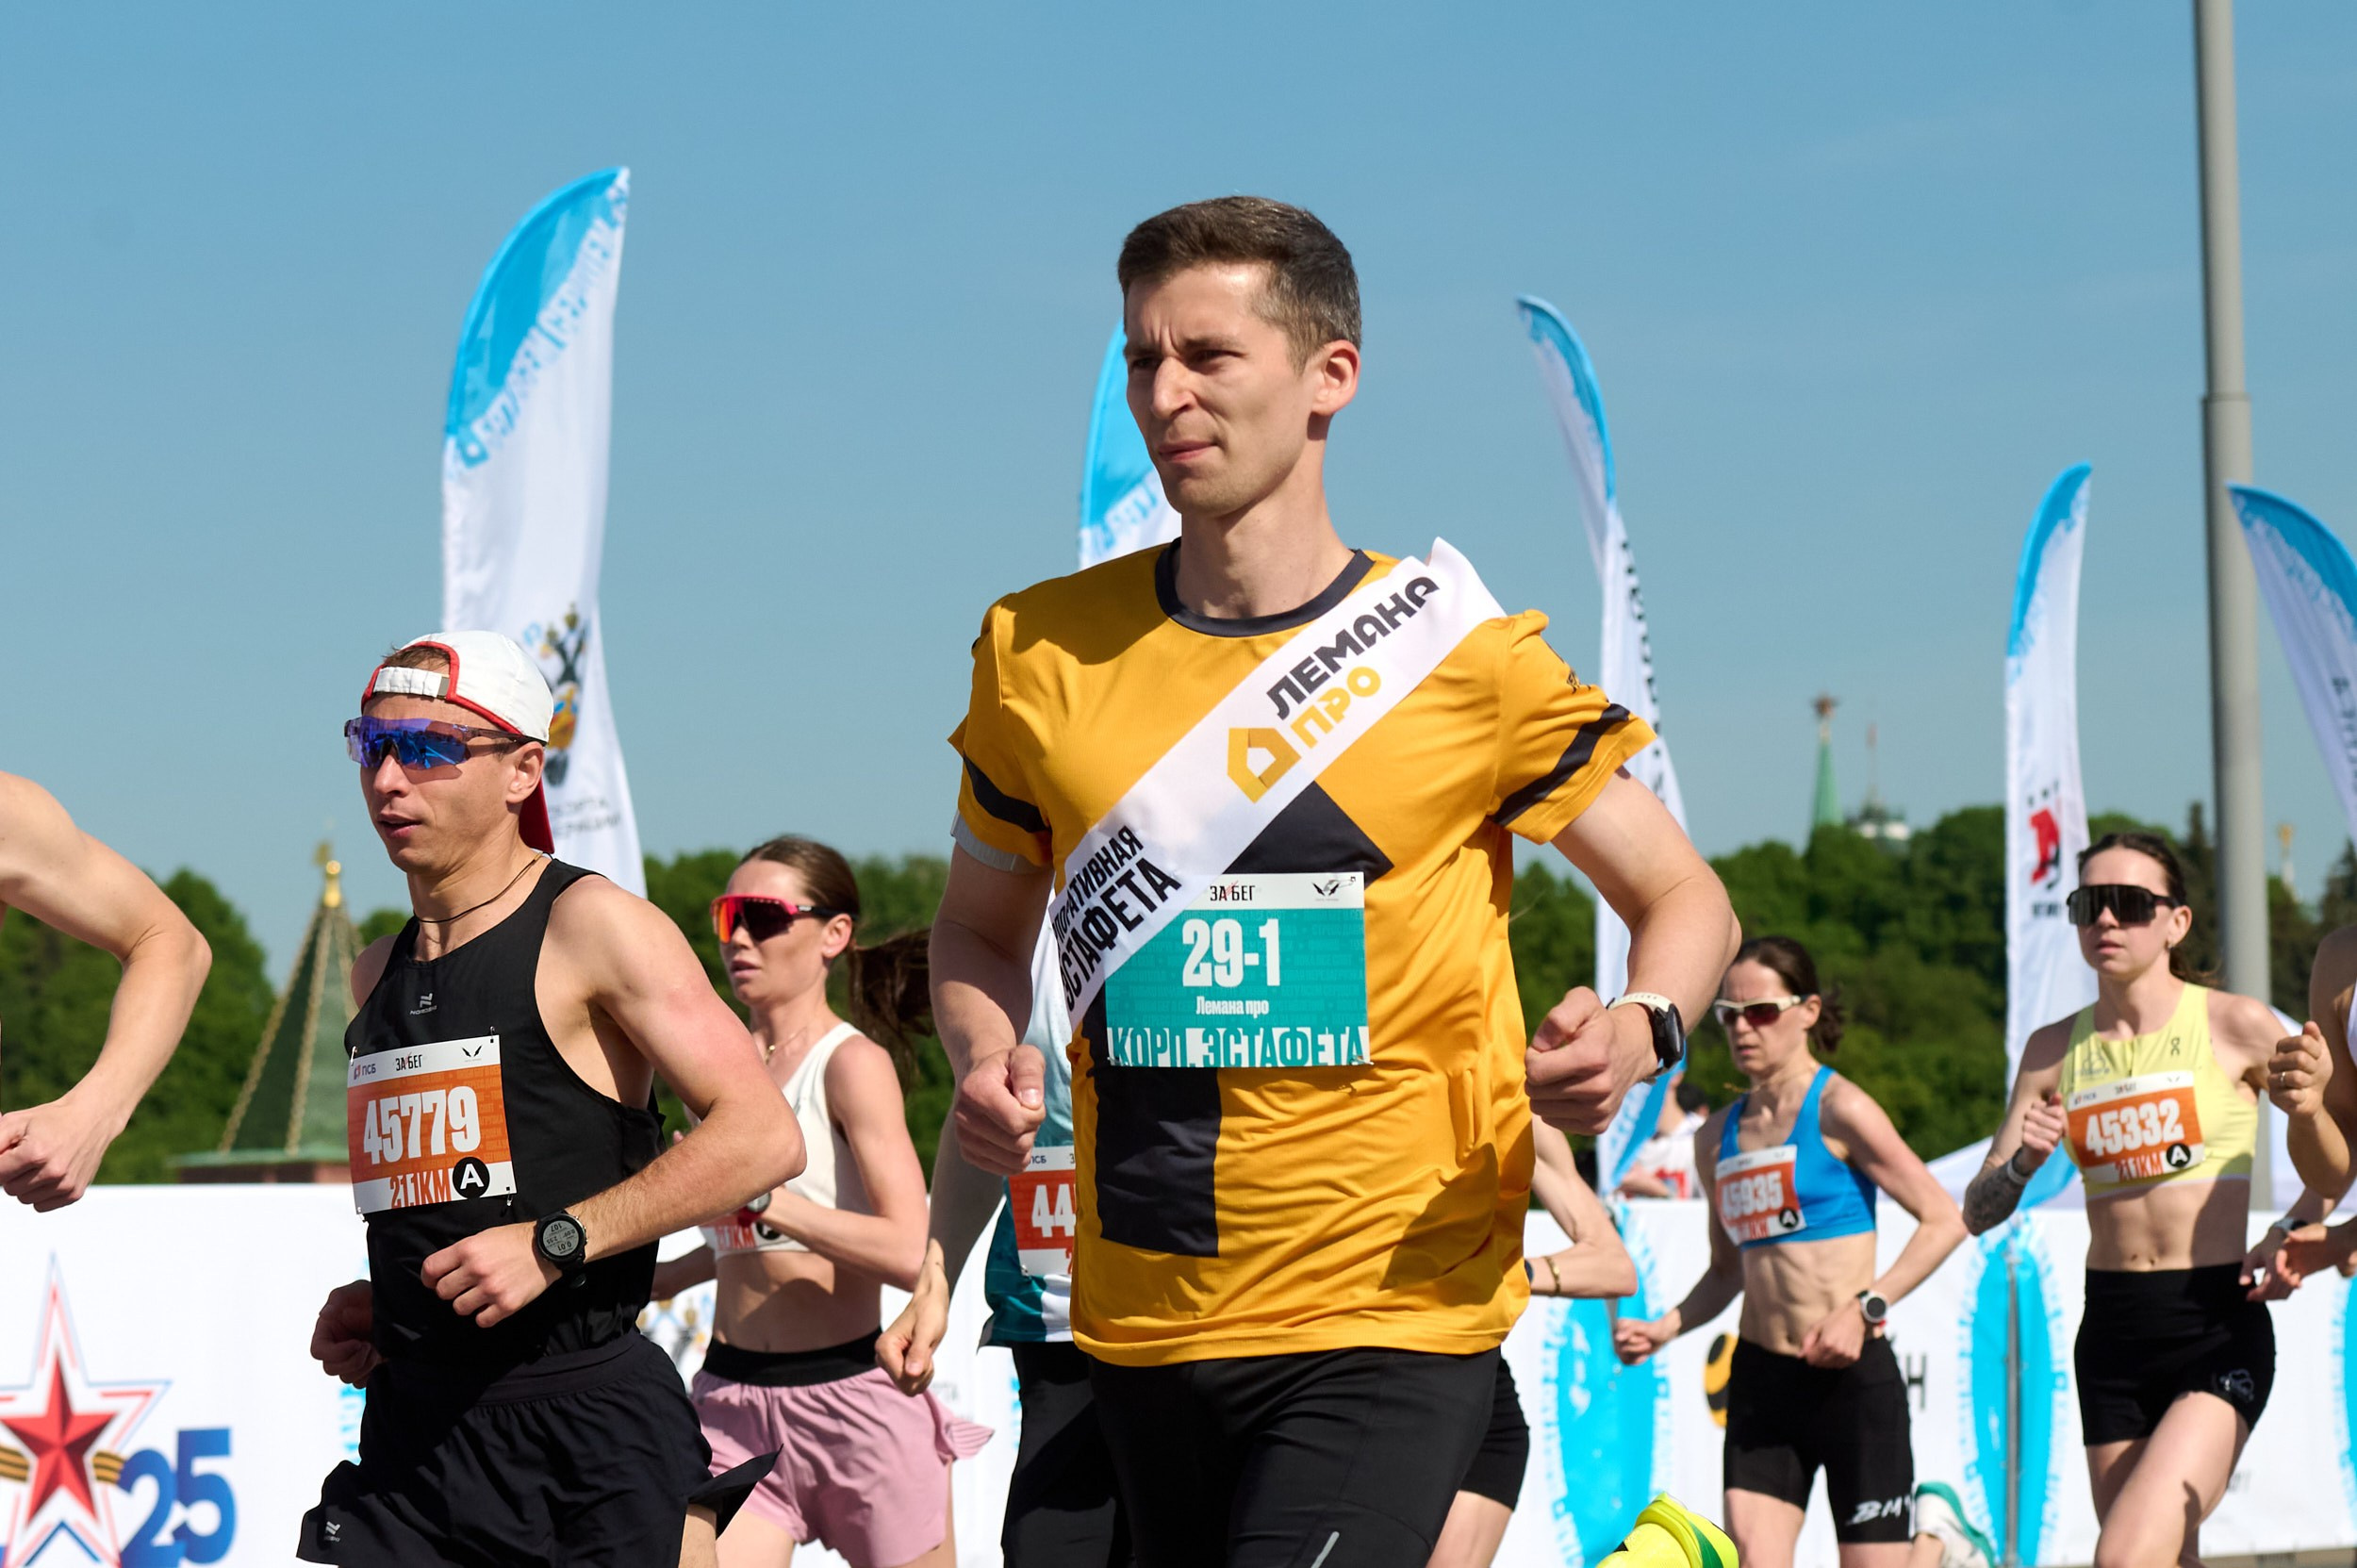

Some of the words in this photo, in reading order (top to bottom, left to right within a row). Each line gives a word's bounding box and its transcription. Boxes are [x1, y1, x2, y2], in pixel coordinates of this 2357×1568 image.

[1266, 576, 1441, 720] ЛЕМАНА
[1290, 666, 1381, 750] ПРО
[1182, 918, 1280, 988] 29-1
[1195, 996, 1244, 1015] Лемана
[1245, 999, 1270, 1019] про
[362, 1063, 376, 1076] ПСБ
[1201, 1026, 1364, 1067] ЭСТАФЕТА
[363, 1086, 481, 1165] 45779
[2085, 1098, 2184, 1158] 45332
[1722, 1171, 1784, 1220] 45935
